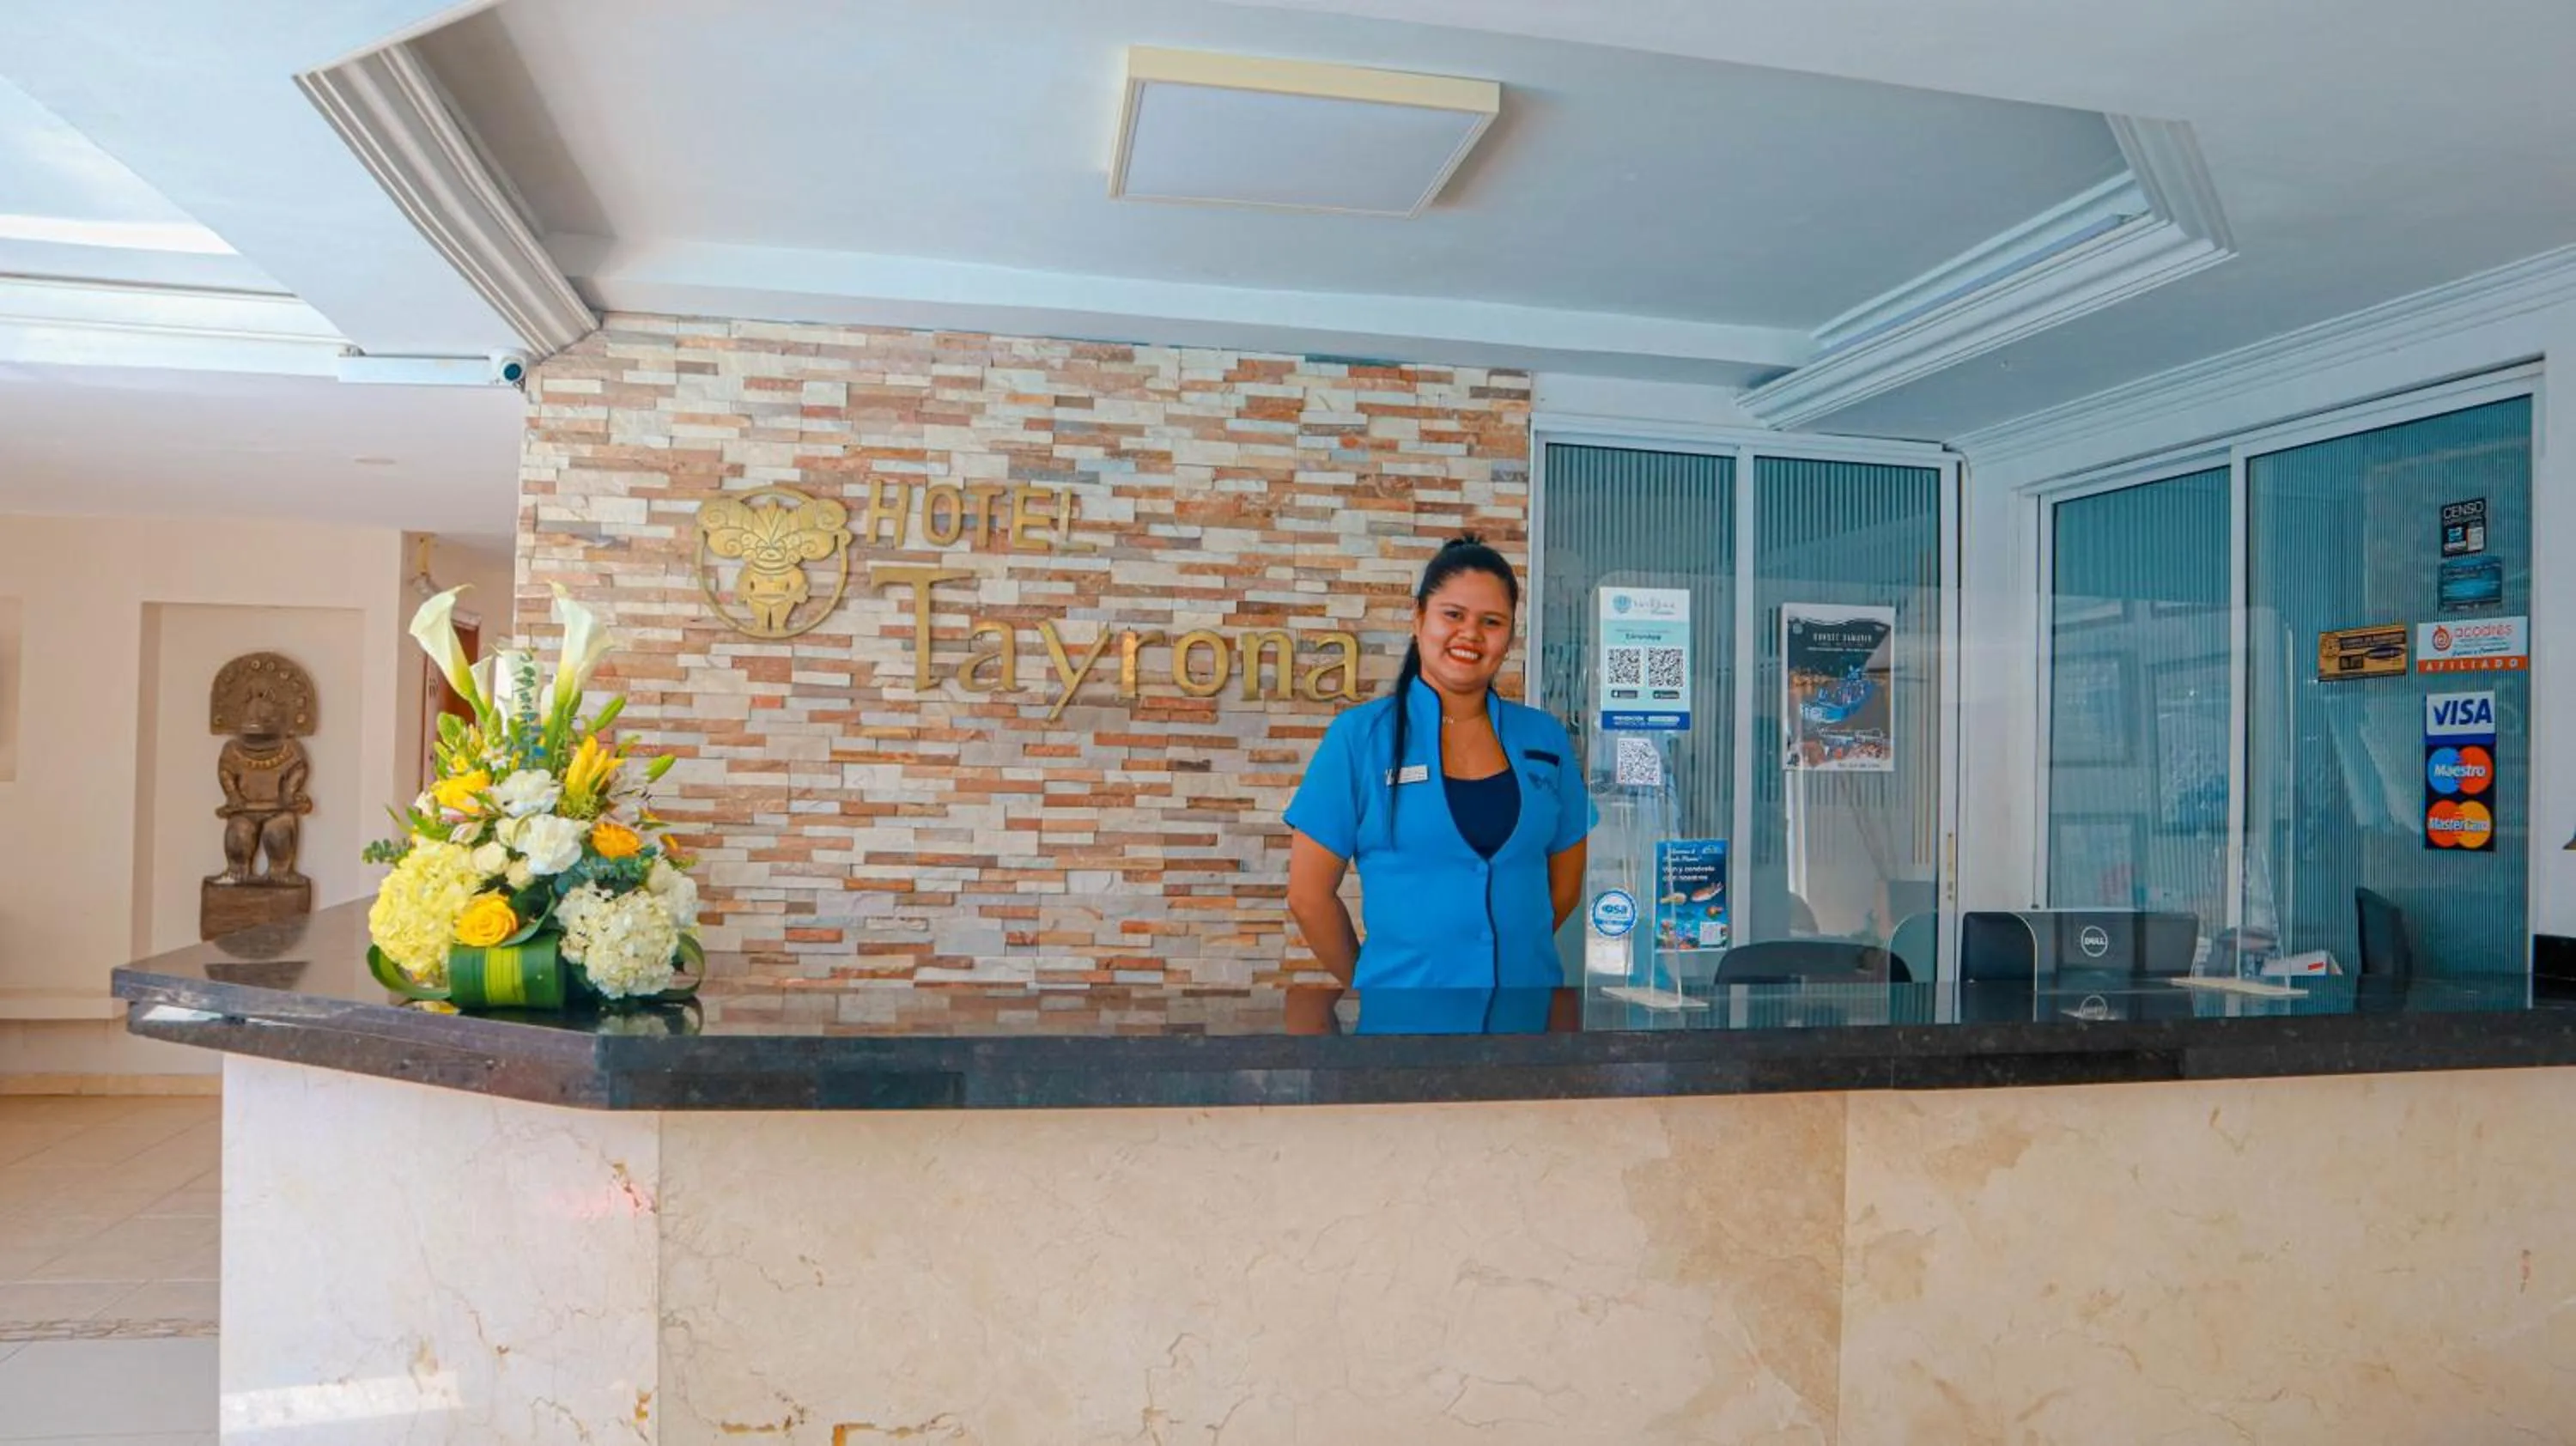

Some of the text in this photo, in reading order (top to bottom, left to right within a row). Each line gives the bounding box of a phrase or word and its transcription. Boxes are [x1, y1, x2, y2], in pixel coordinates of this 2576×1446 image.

[866, 479, 1097, 554] HOTEL
[2444, 501, 2484, 519] CENSO
[871, 567, 1363, 722] Tayrona
[2426, 658, 2518, 671] AFILIADO
[2433, 698, 2494, 726] VISA
[2433, 763, 2487, 777] Maestro
[2084, 936, 2105, 945] DELL
